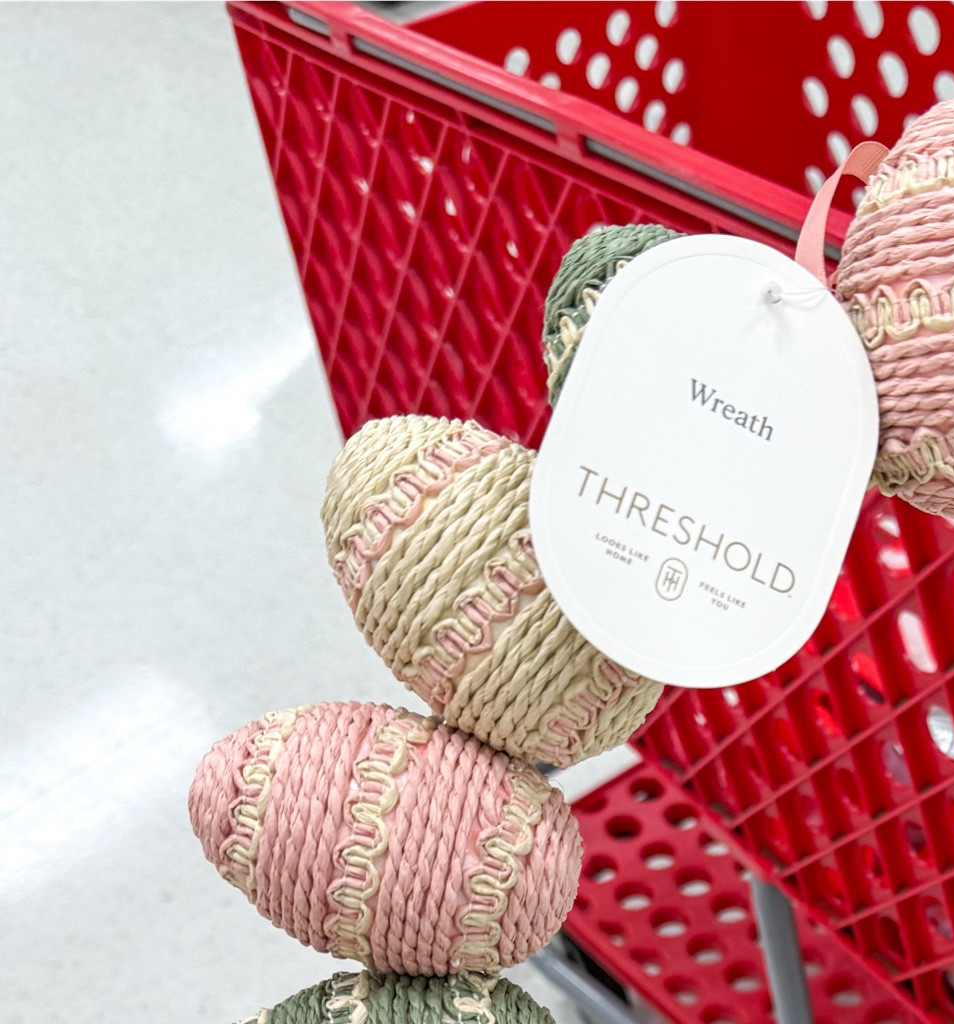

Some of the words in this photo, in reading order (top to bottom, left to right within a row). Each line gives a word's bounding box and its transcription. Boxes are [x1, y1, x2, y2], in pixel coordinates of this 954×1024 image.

[690, 378, 775, 442] Wreath
[578, 465, 796, 594] THRESHOLD
[595, 532, 627, 552] LOOKS
[628, 547, 649, 563] LIKE
[605, 548, 632, 566] HOME
[699, 581, 725, 599] FEELS
[726, 594, 747, 609] LIKE
[711, 598, 729, 611] YOU
